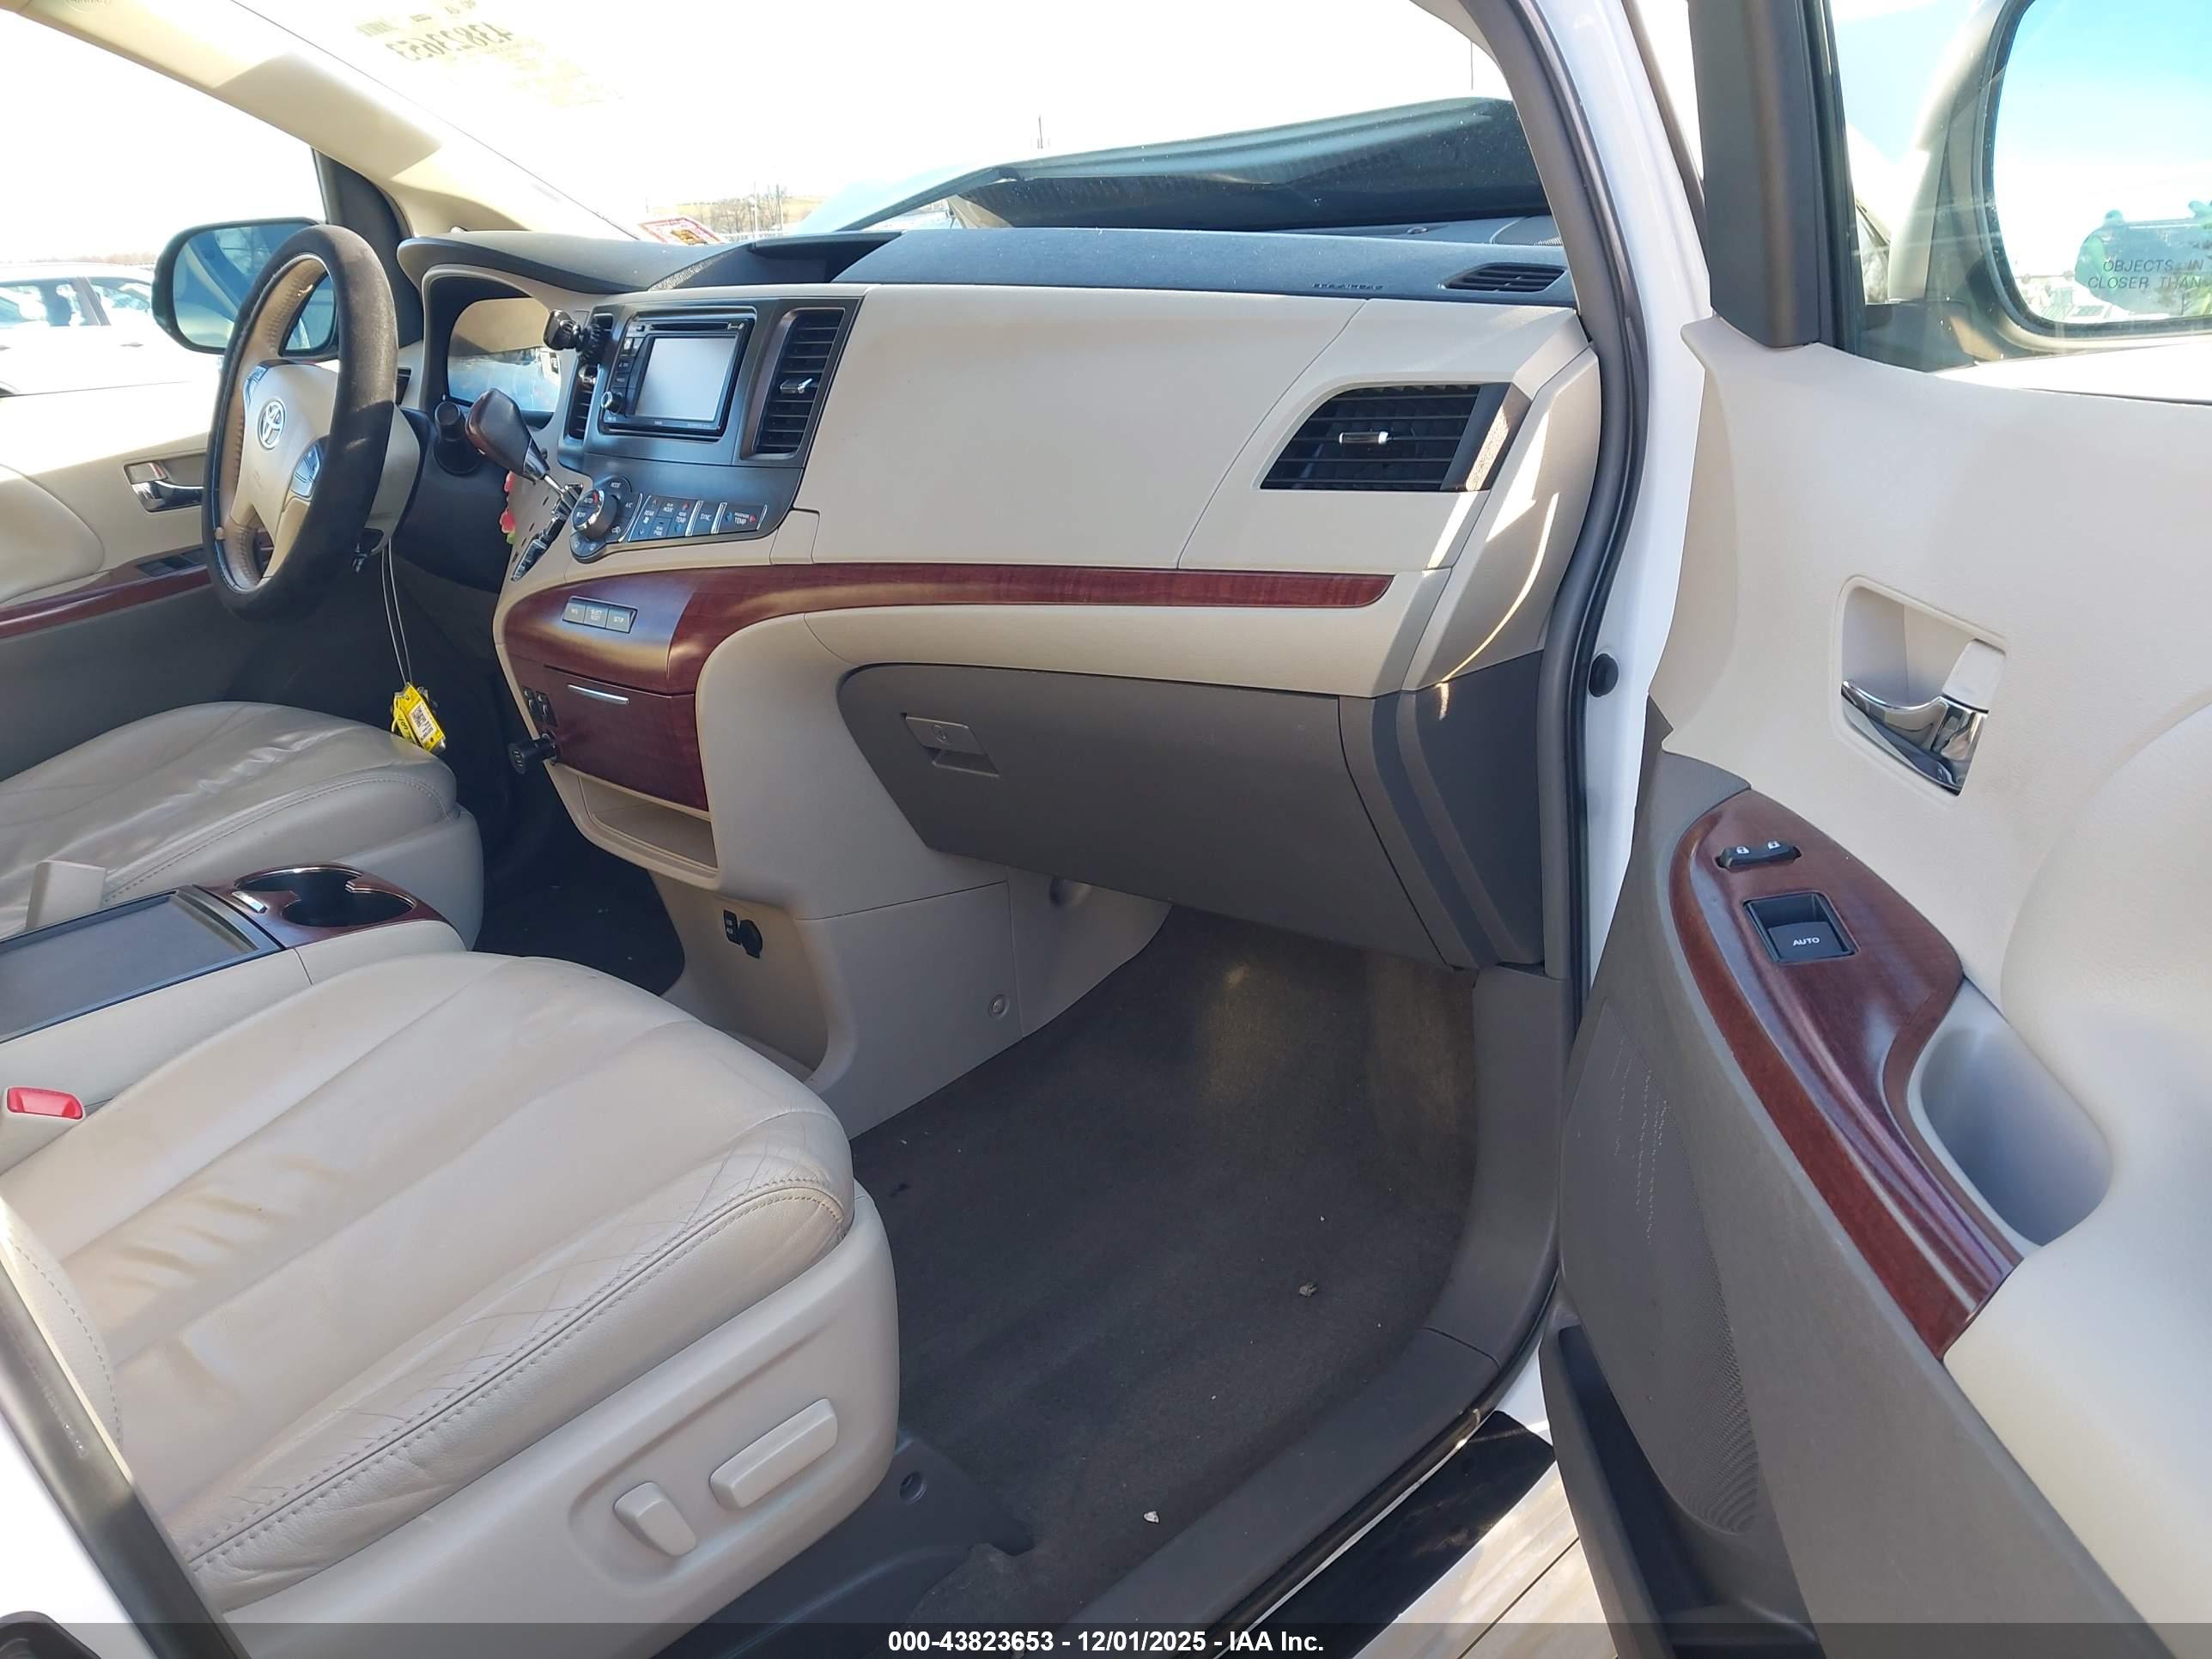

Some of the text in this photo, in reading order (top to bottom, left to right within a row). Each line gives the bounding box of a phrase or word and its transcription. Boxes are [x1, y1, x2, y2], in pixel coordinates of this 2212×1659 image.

[2103, 259, 2204, 272] OBJECTS IN
[2087, 276, 2202, 289] CLOSER THAN
[1792, 937, 1820, 947] AUTO
